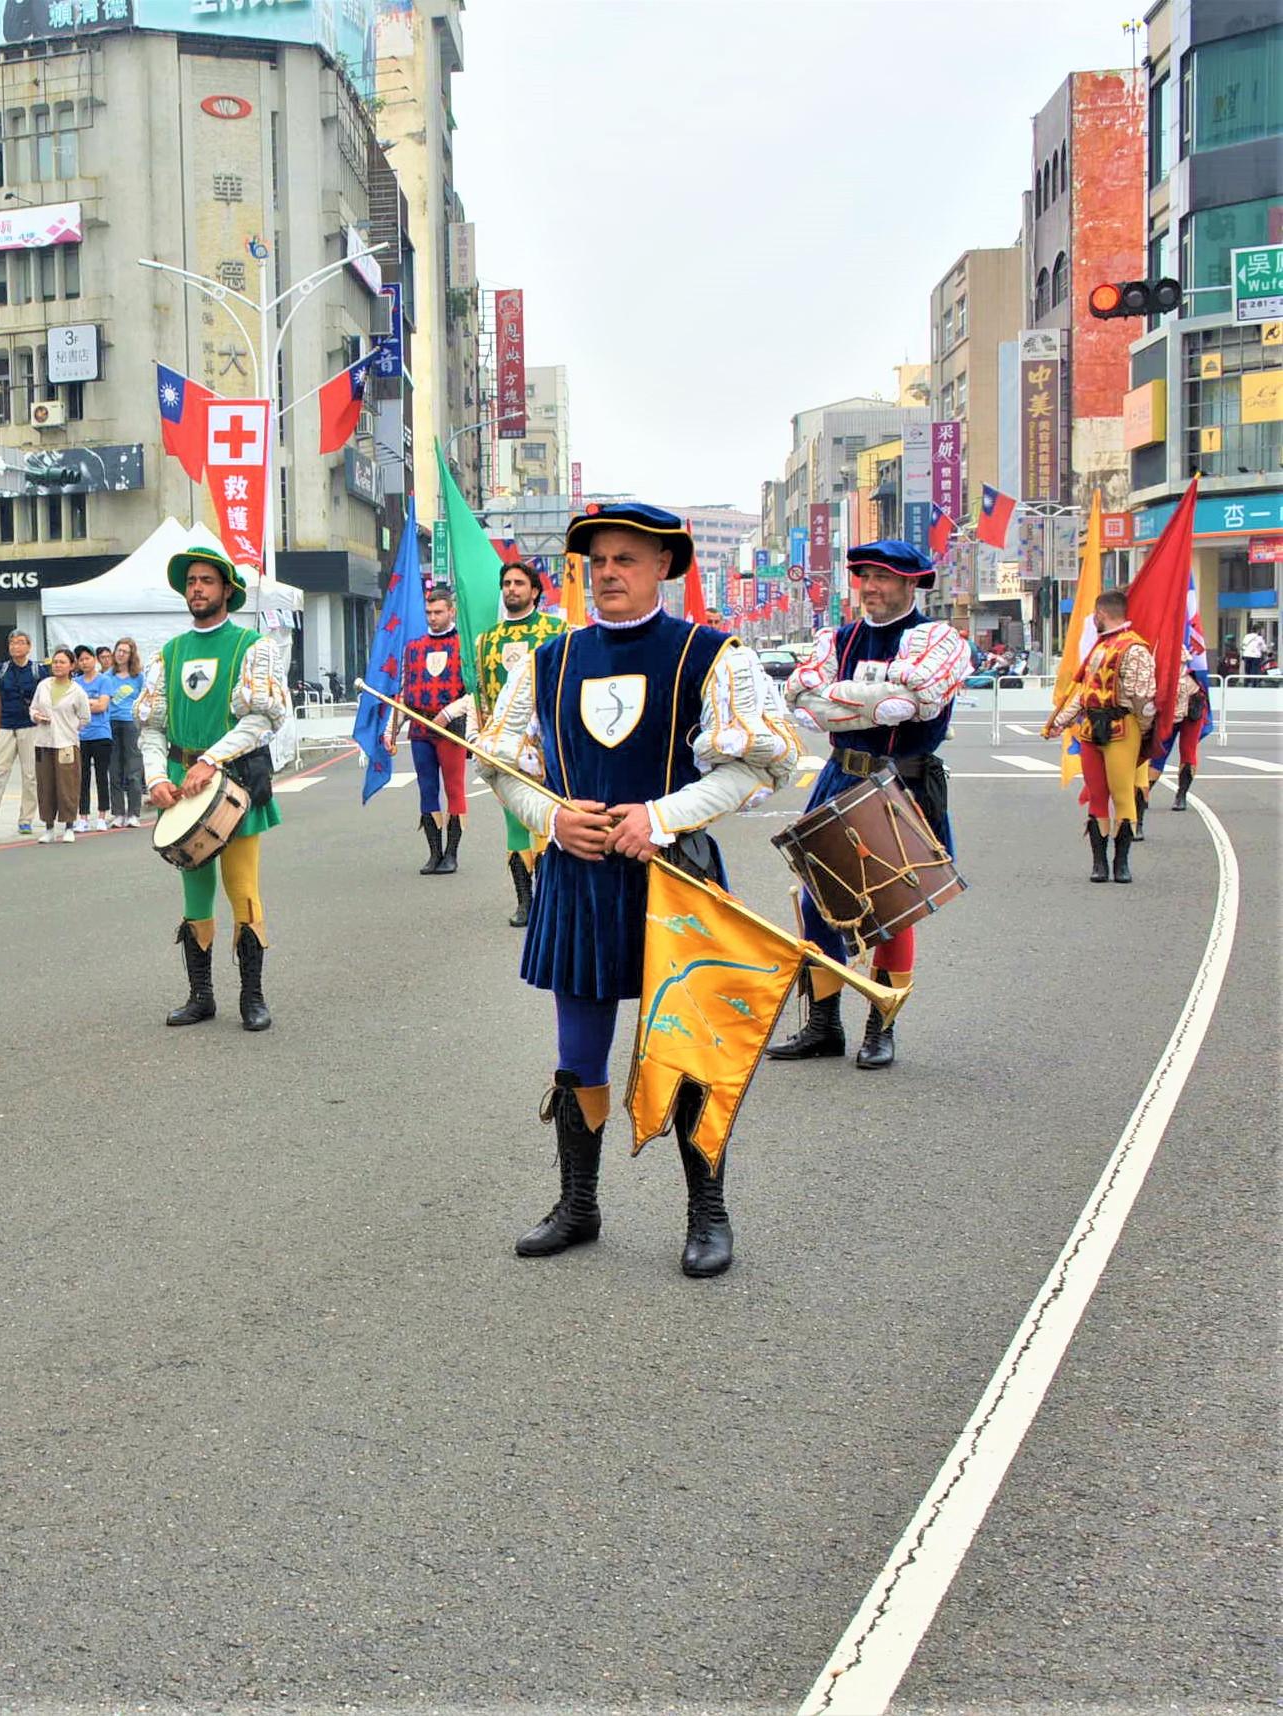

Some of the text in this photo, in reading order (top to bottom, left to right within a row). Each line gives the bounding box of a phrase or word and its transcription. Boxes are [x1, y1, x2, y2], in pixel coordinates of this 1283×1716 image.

[64, 330, 78, 346] 3F
[1027, 364, 1054, 419] 中美
[1224, 503, 1283, 528] 杏一
